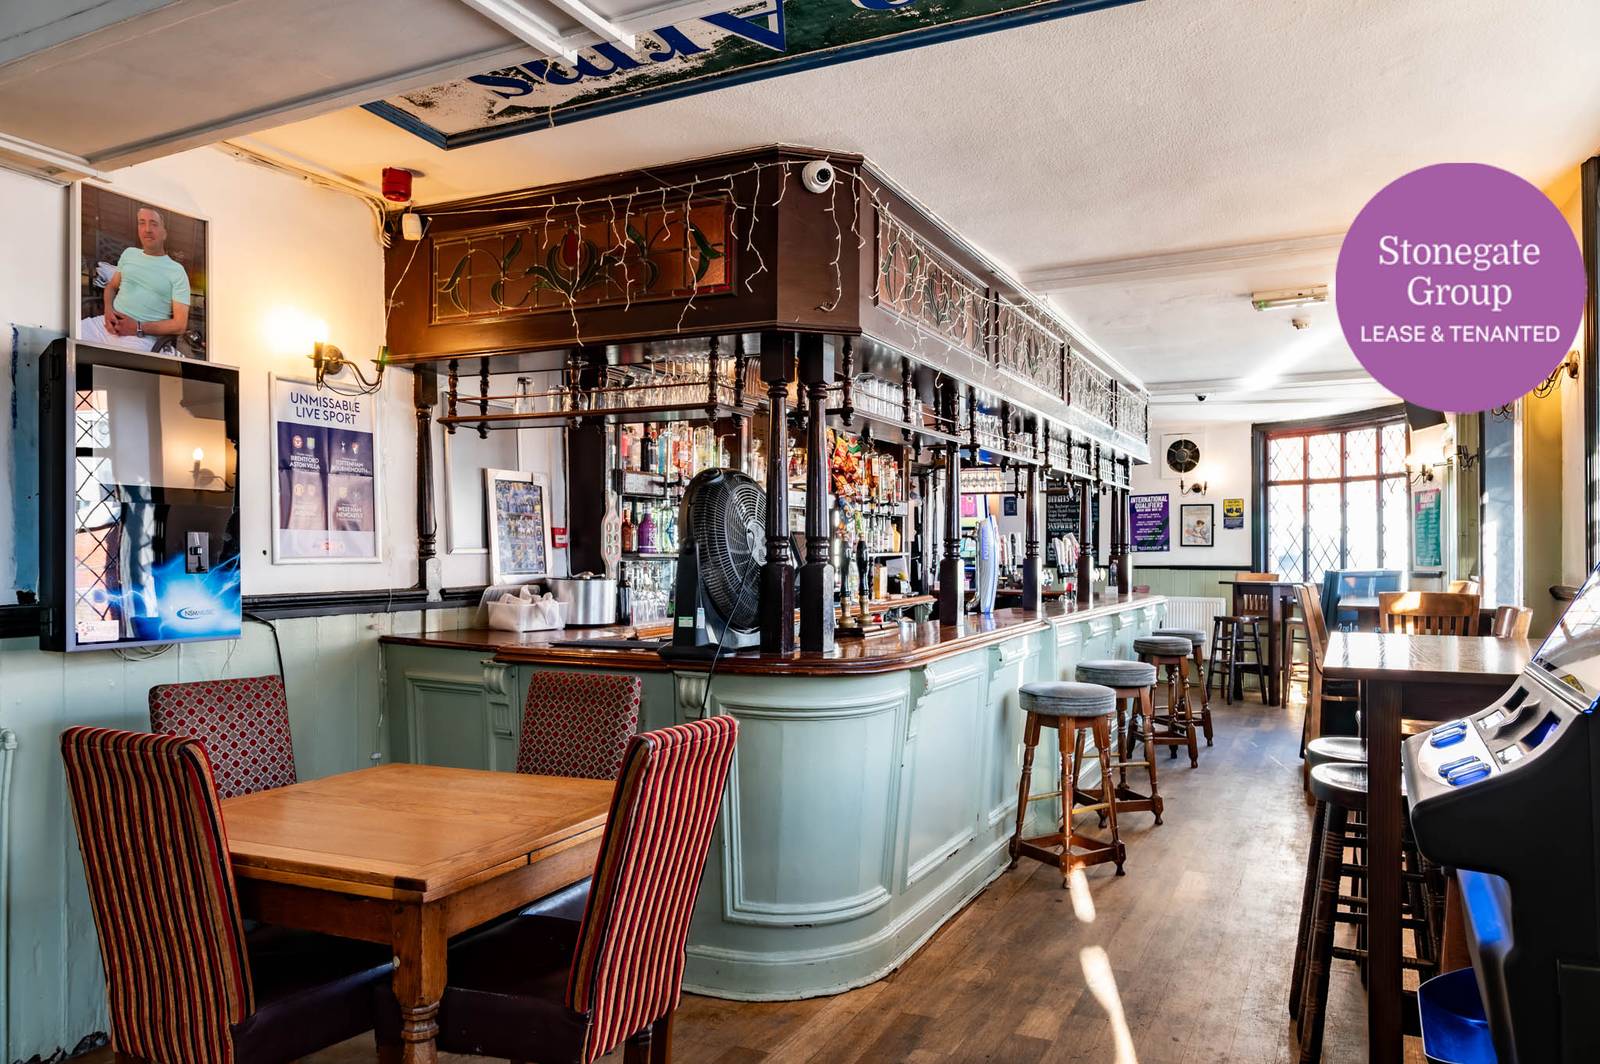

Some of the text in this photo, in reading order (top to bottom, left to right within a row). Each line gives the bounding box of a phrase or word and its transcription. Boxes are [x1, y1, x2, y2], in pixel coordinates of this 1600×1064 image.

[290, 392, 360, 413] UNMISSABLE
[296, 407, 357, 425] LIVE SPORT
[1130, 495, 1168, 503] INTERNATIONAL
[1134, 501, 1164, 509] QUALIFIERS
